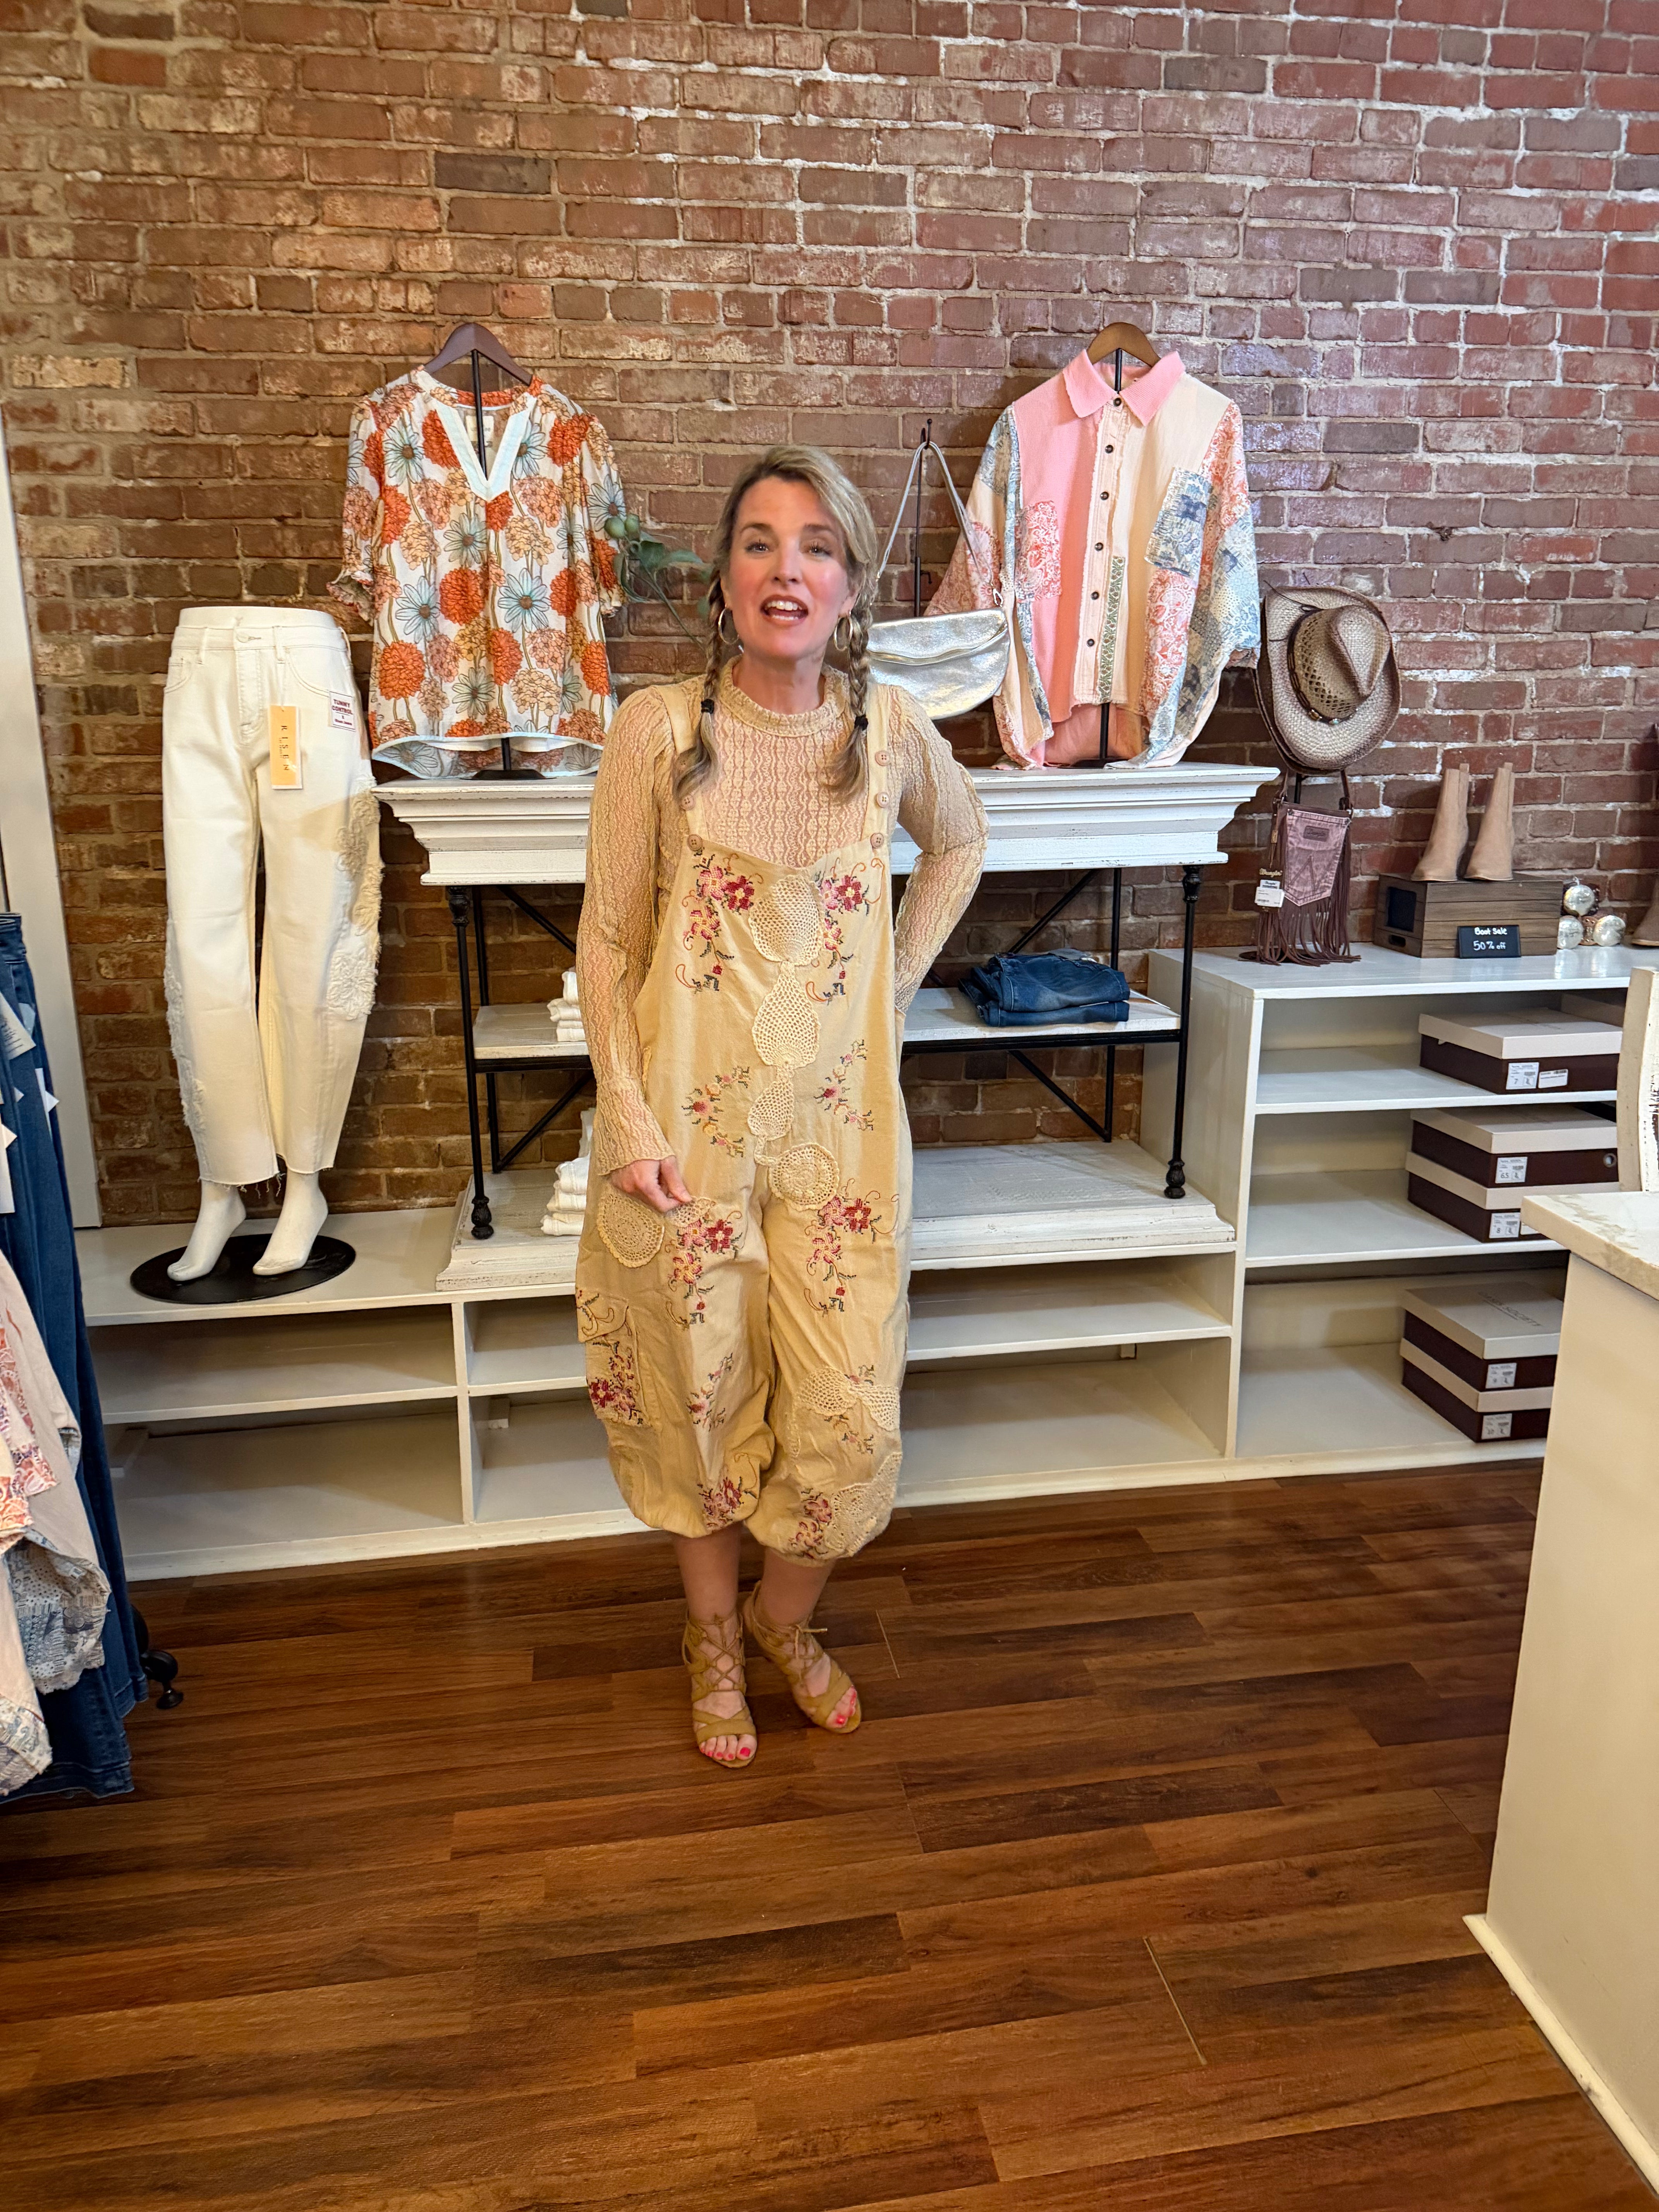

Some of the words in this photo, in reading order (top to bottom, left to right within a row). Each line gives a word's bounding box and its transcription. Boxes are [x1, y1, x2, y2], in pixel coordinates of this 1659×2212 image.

[333, 699, 350, 708] TUMMY
[331, 705, 354, 715] CONTROL
[1474, 927, 1491, 936] Boot
[1492, 927, 1508, 935] Sale
[1473, 940, 1495, 951] 50%
[1496, 942, 1506, 950] off
